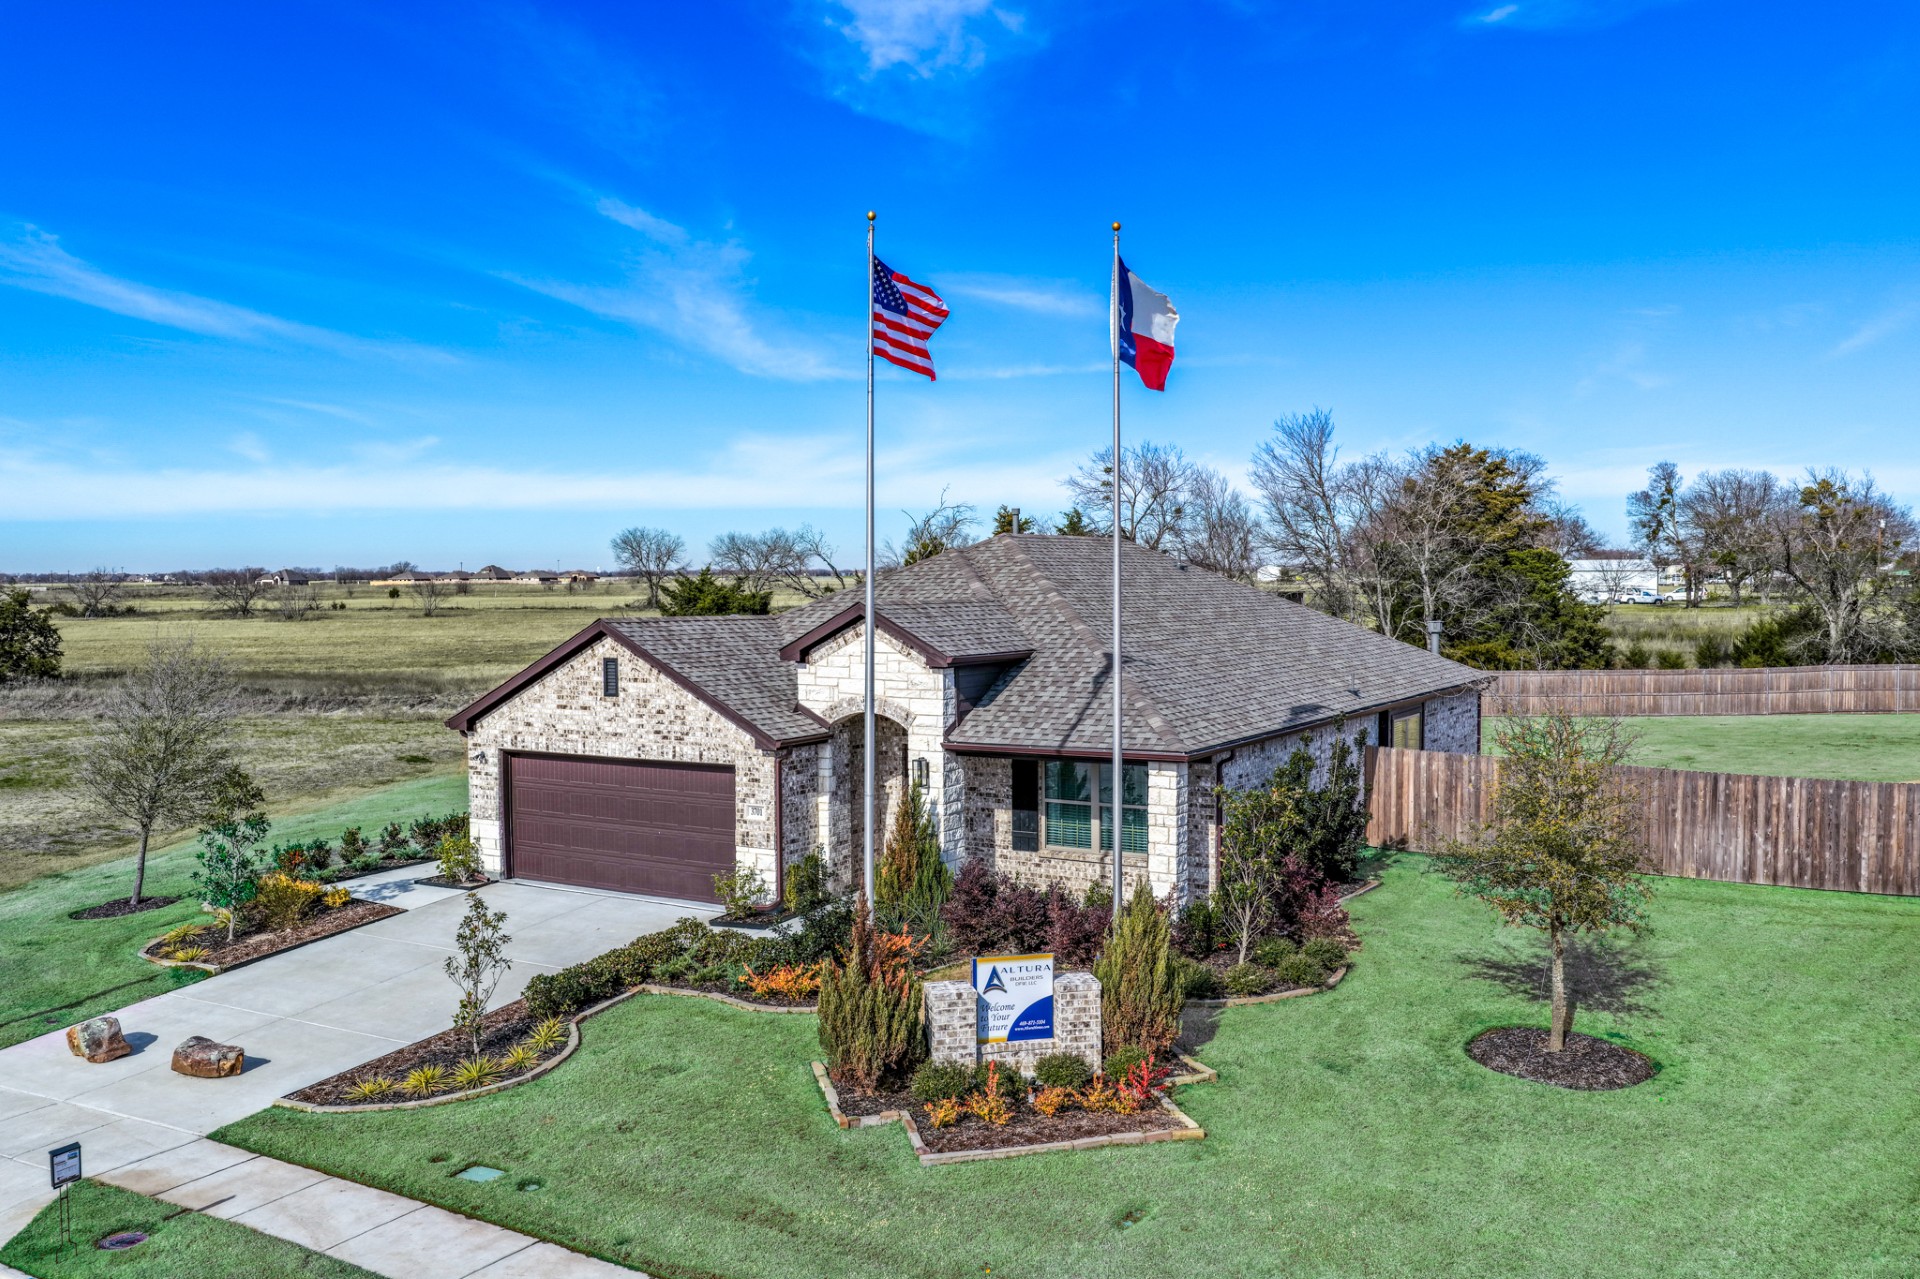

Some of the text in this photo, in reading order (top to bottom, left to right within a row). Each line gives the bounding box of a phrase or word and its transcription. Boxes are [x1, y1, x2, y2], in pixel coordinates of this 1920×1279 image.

[1001, 964, 1051, 974] ALTURA
[981, 1002, 1015, 1012] Welcome
[991, 1013, 1010, 1022] Your
[981, 1023, 1008, 1032] Future
